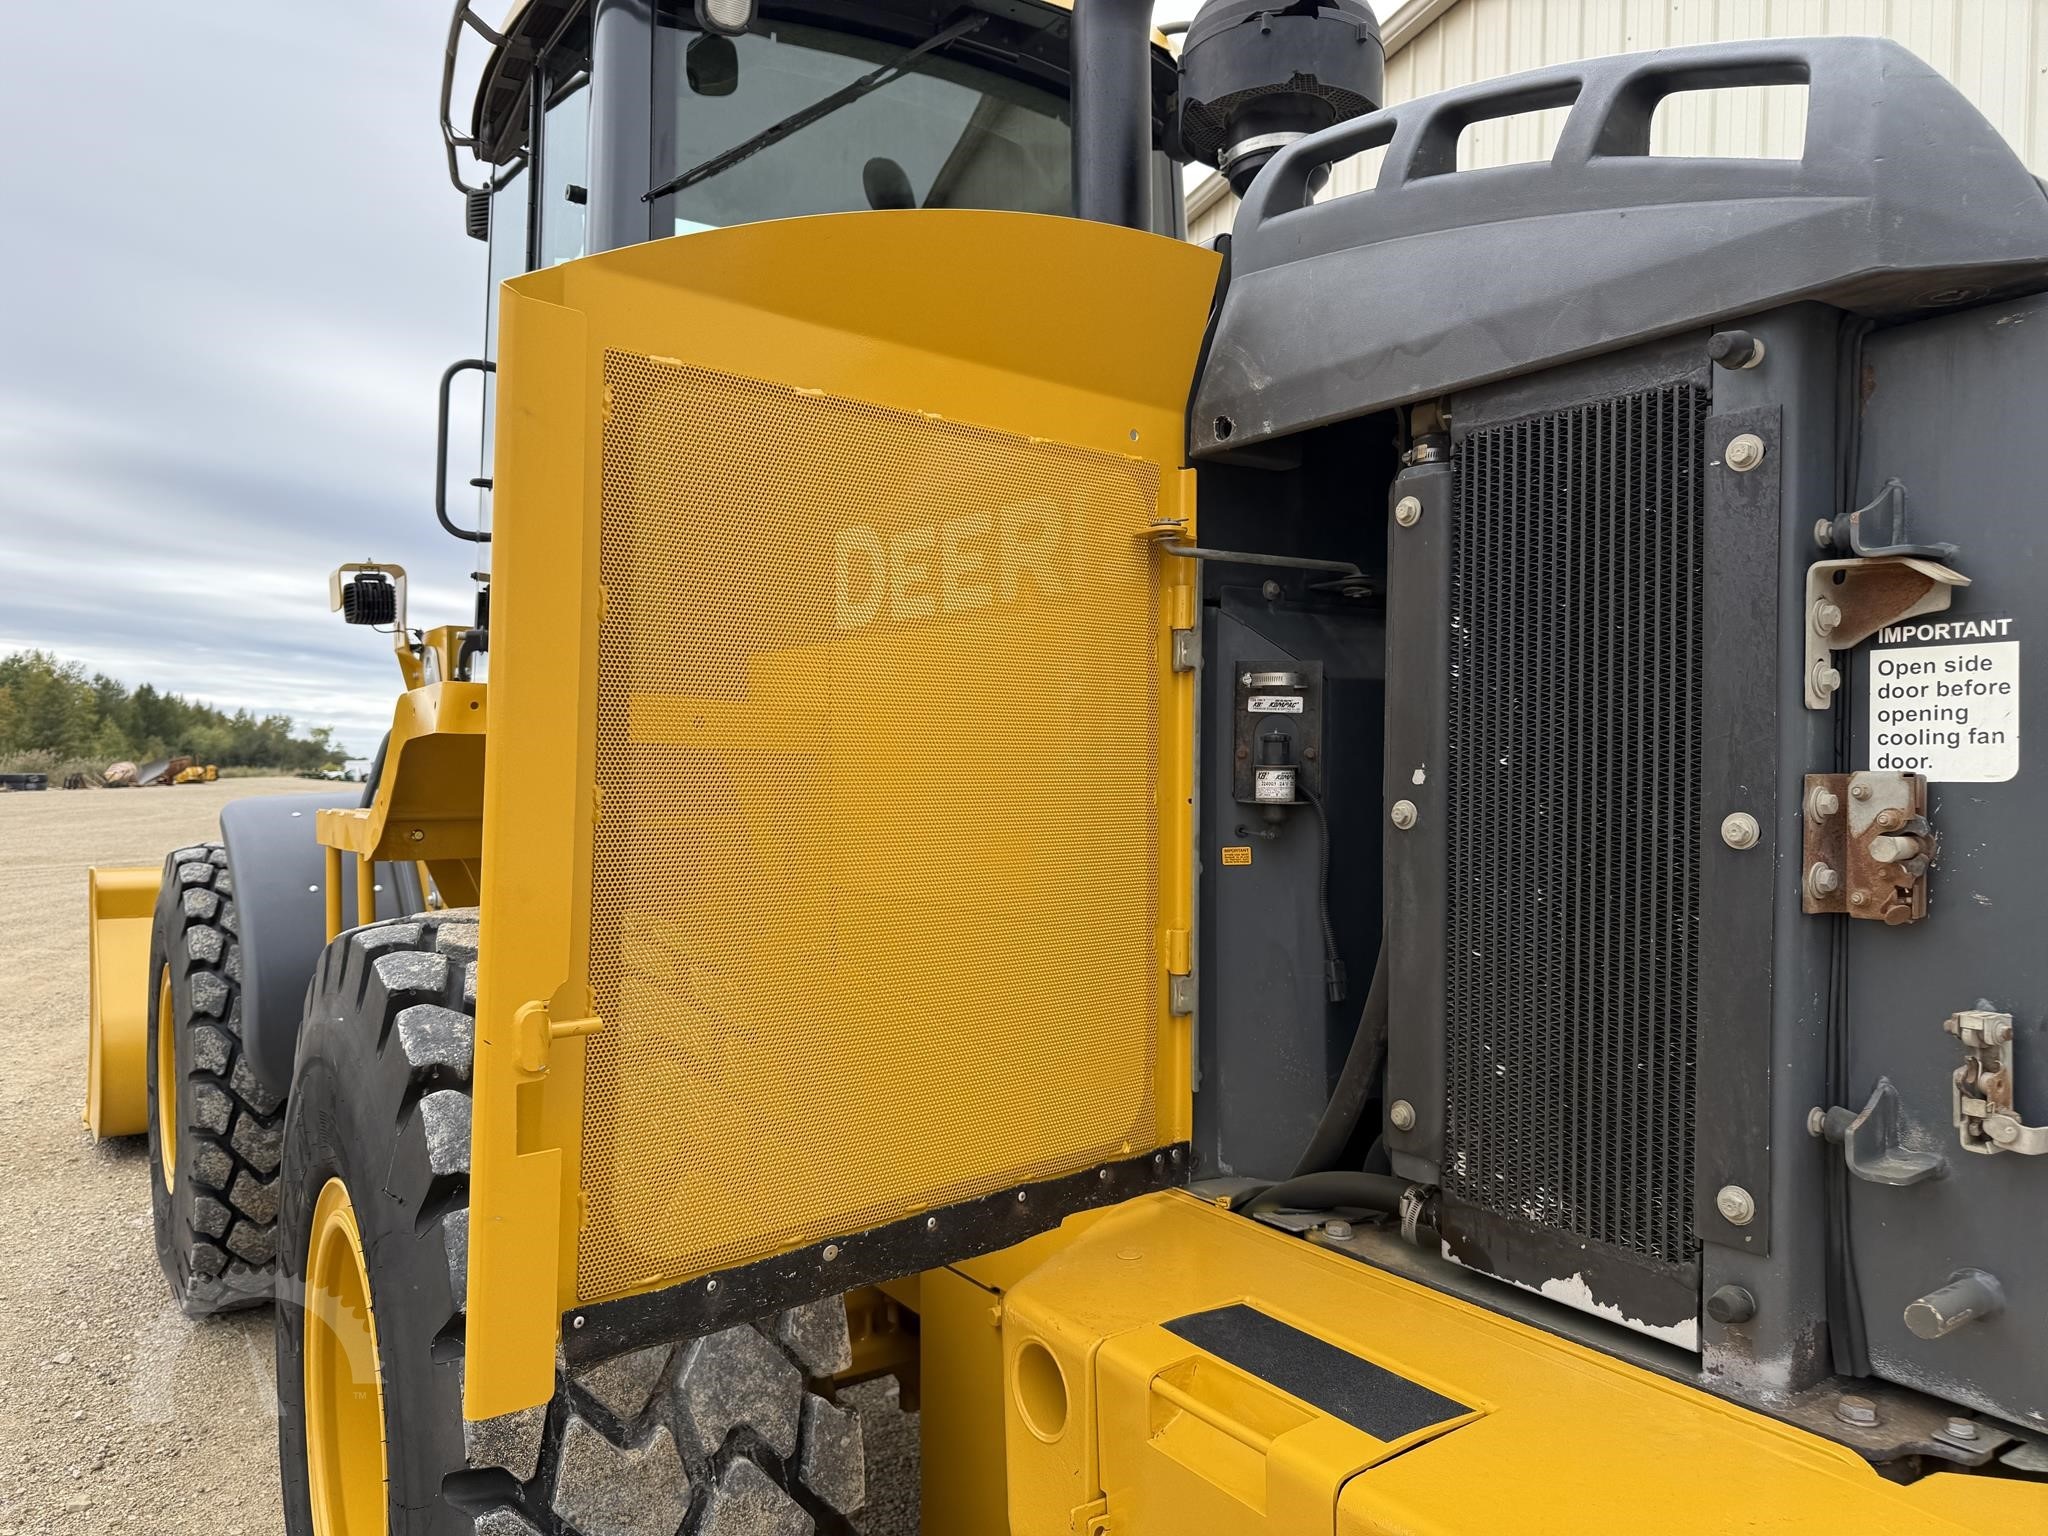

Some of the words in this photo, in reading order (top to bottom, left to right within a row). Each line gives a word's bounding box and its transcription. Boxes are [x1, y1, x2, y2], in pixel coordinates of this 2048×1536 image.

[1878, 618, 2013, 644] IMPORTANT
[1877, 659, 1936, 680] Open
[1944, 655, 1993, 673] side
[1877, 683, 1929, 699] door
[1937, 679, 2011, 697] before
[1877, 704, 1968, 726] opening
[1877, 728, 1960, 749] cooling
[1968, 727, 2005, 745] fan
[1877, 753, 1933, 769] door.
